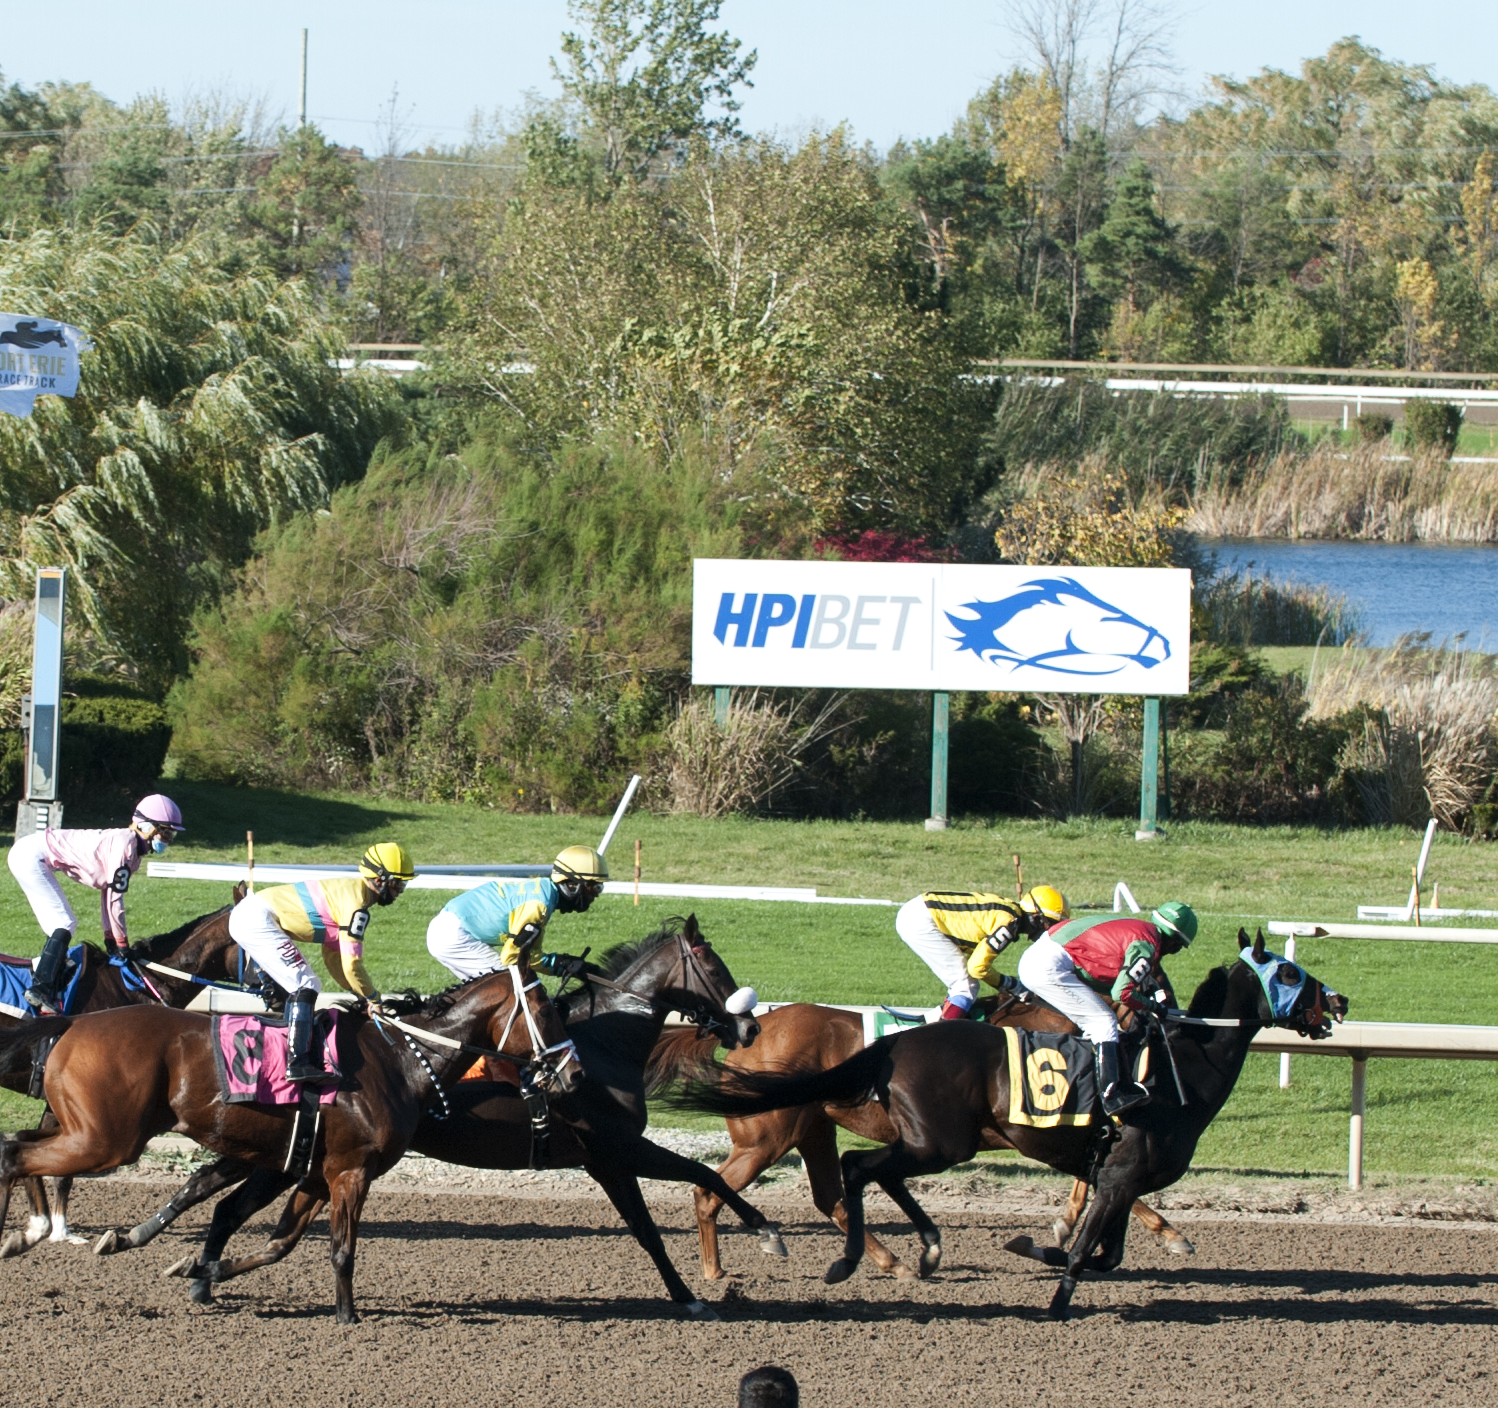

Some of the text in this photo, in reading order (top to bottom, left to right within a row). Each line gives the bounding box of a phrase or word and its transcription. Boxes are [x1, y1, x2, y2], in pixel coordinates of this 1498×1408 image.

[29, 354, 66, 376] ERIE
[24, 375, 56, 388] TRACK
[713, 592, 923, 652] HPIBET
[115, 869, 130, 891] 3
[351, 911, 369, 936] 8
[988, 926, 1013, 950] 5
[232, 1029, 264, 1086] 8
[1026, 1047, 1070, 1111] 6
